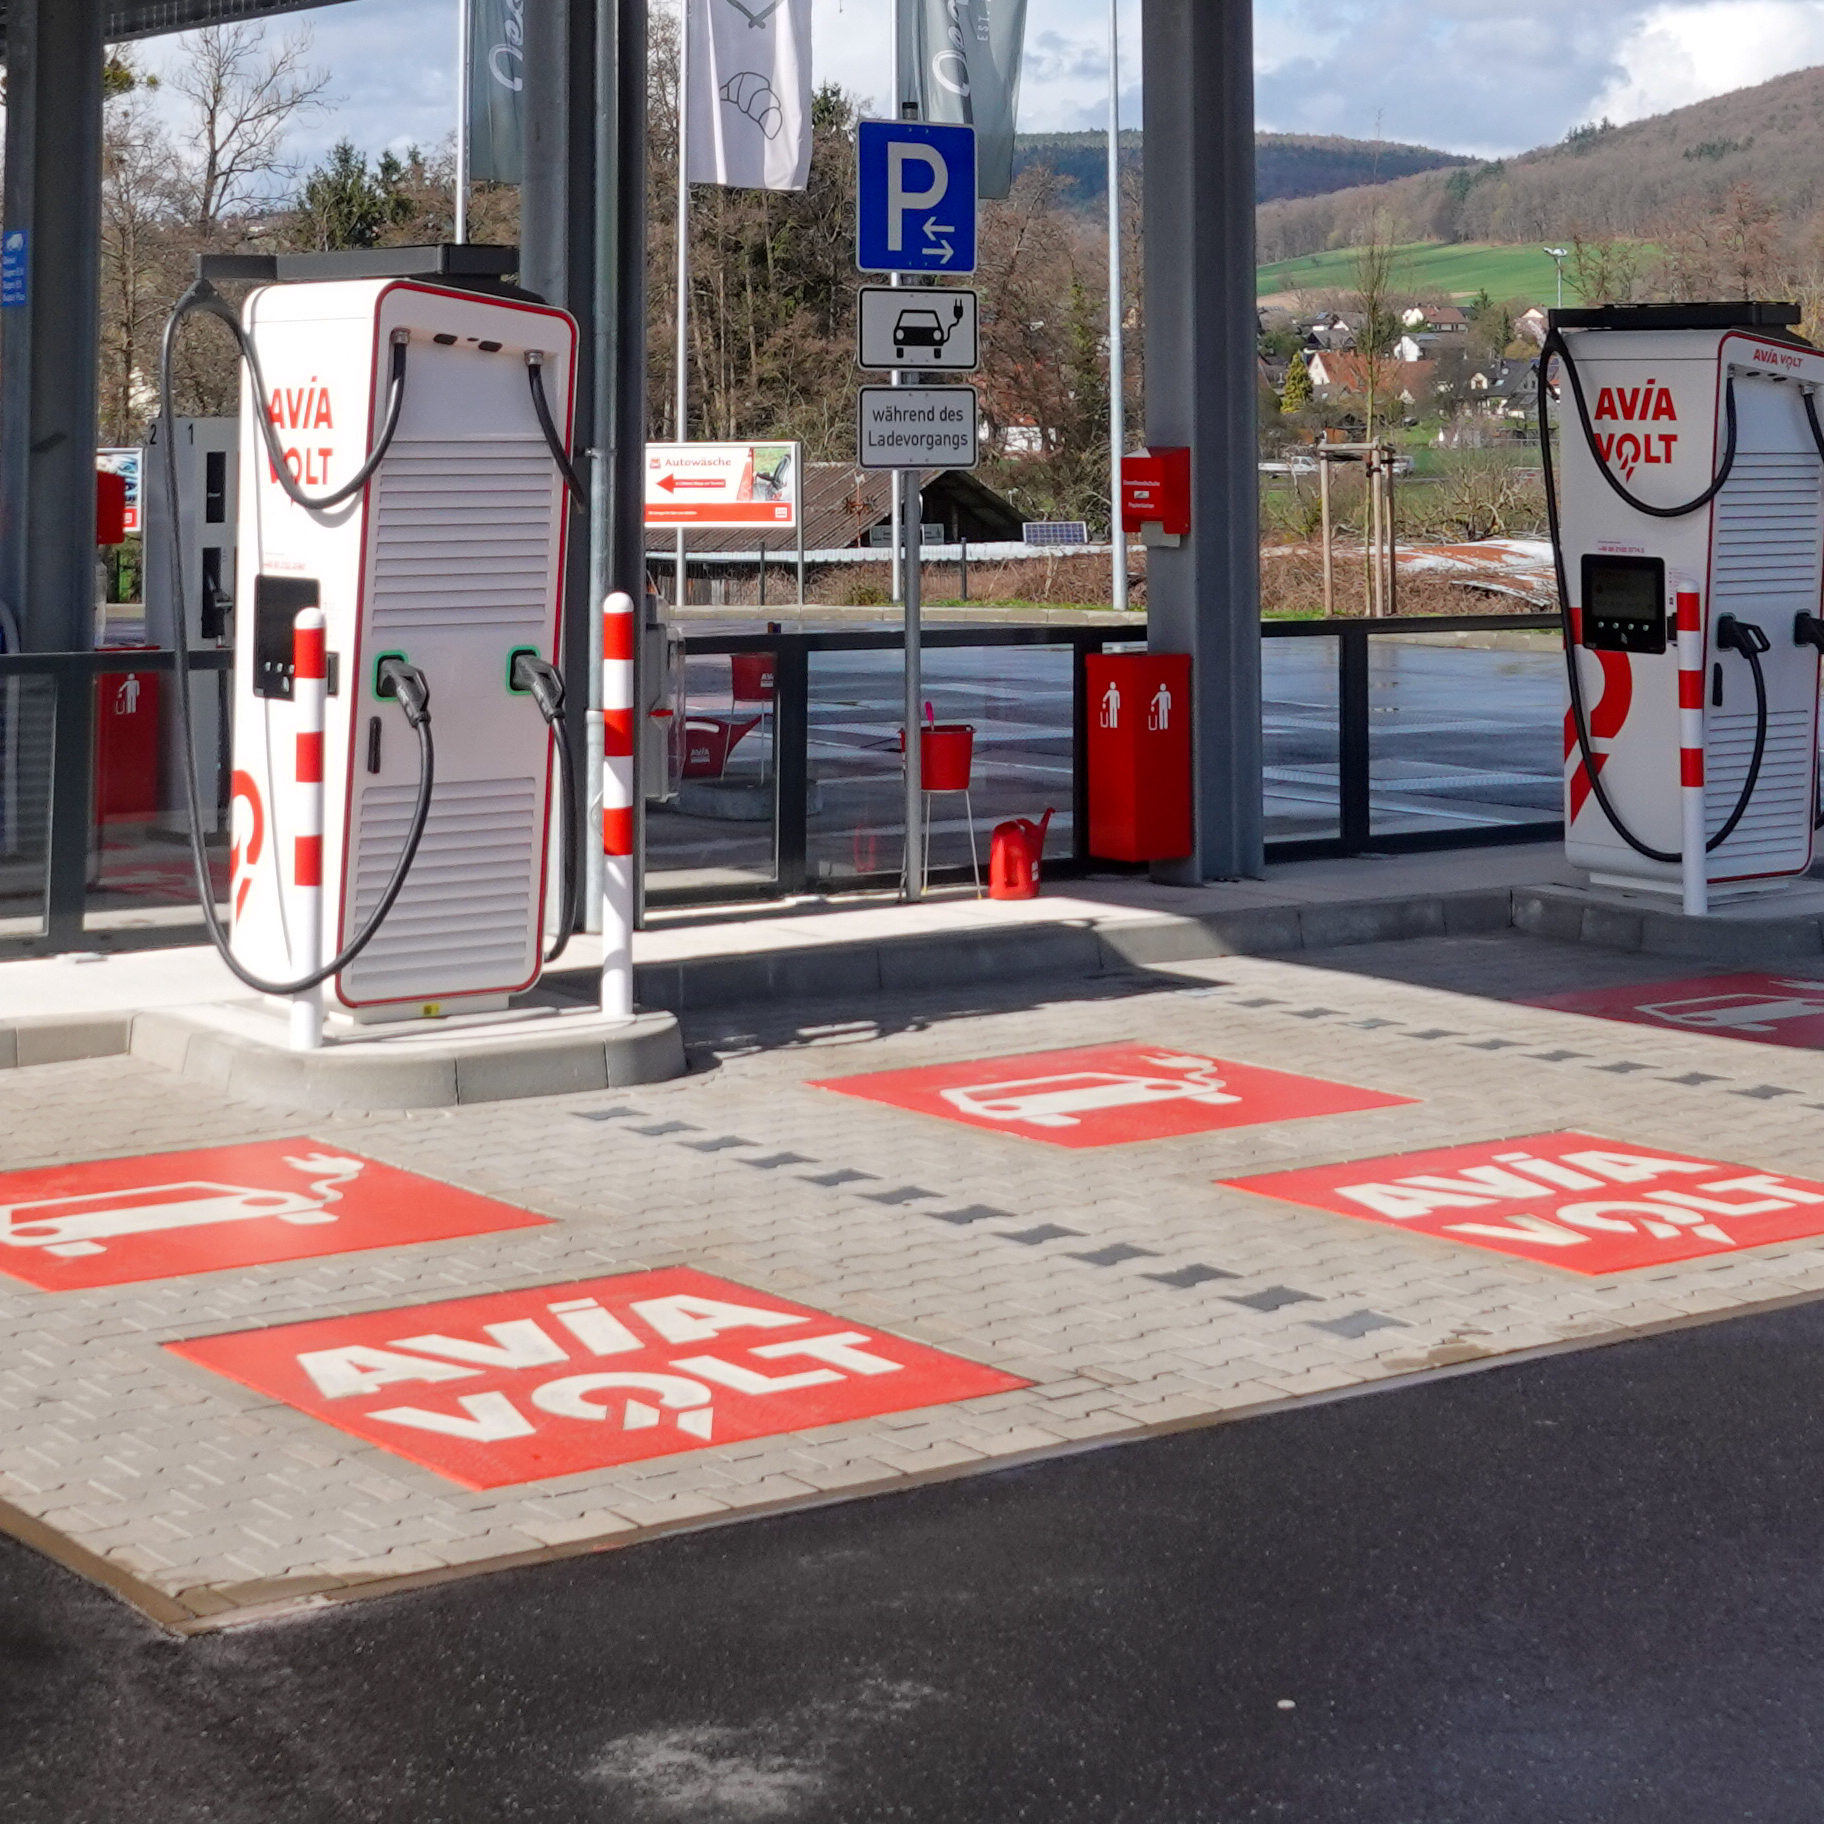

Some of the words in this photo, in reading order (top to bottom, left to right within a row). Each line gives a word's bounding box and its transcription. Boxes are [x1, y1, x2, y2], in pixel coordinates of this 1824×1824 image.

[976, 10, 991, 42] EST.
[887, 141, 949, 252] P
[1780, 353, 1804, 371] VOLT
[268, 375, 334, 429] AVIA
[872, 405, 935, 422] während
[938, 405, 964, 422] des
[1594, 378, 1678, 421] AVIA
[149, 423, 157, 445] 2
[188, 422, 194, 445] 1
[868, 430, 968, 450] Ladevorgangs
[664, 457, 732, 467] Autowäsche
[1593, 432, 1678, 482] VOLT
[1333, 1149, 1719, 1219] AVIA
[296, 1293, 813, 1401] AVIA
[364, 1331, 906, 1442] VOLT
